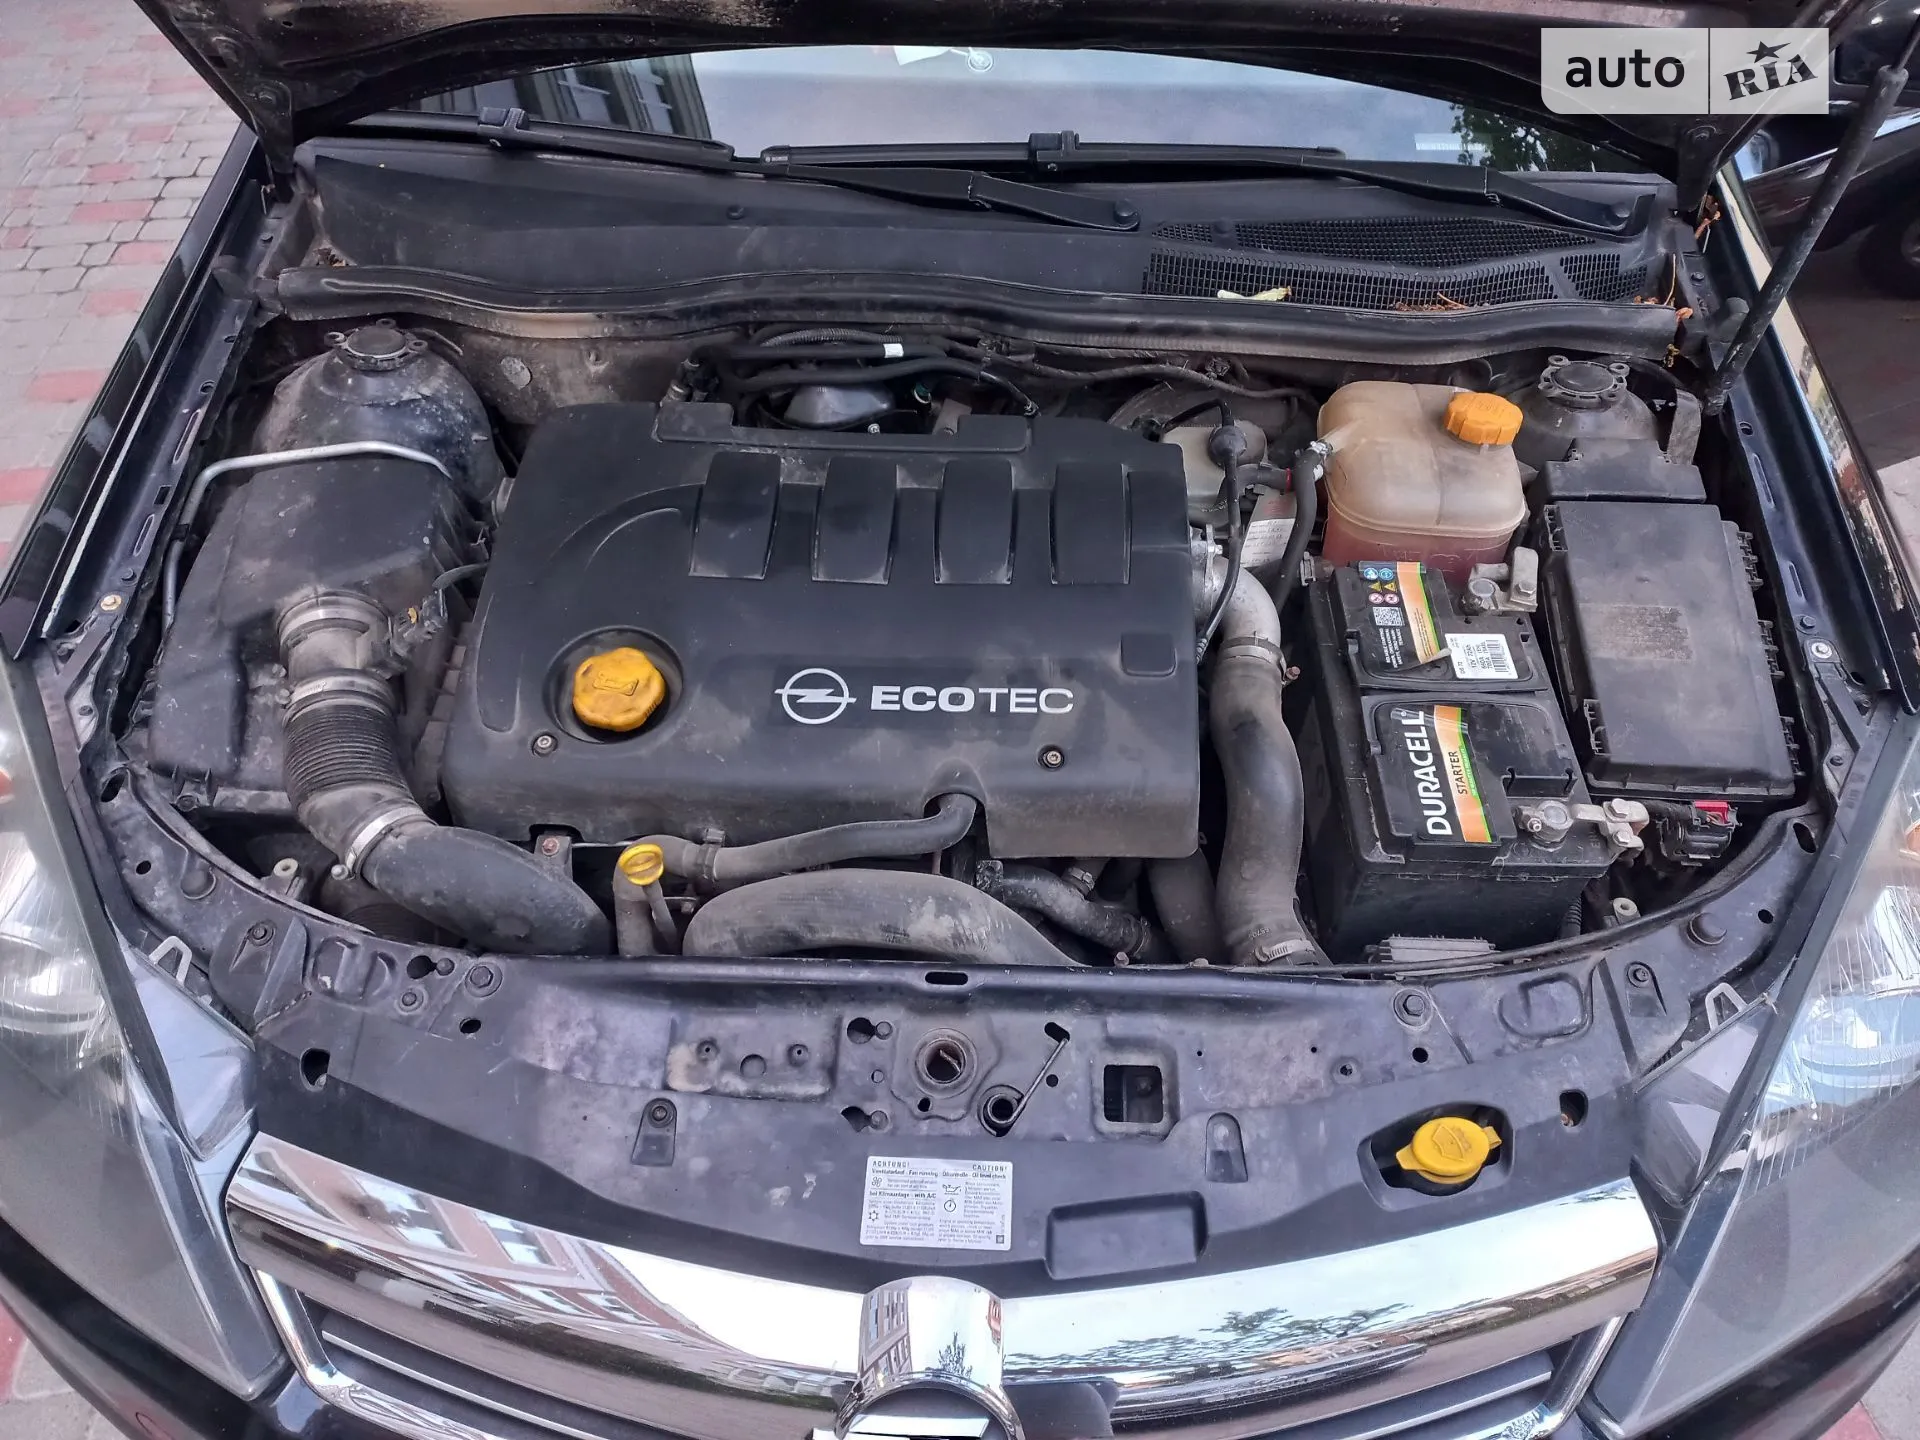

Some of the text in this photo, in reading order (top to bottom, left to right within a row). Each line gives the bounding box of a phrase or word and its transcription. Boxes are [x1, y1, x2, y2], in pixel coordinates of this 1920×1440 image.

[870, 685, 1074, 714] ECOTEC
[1401, 711, 1453, 836] DURACELL
[1449, 750, 1468, 795] STARTER
[872, 1160, 910, 1168] ACHTUNG!
[972, 1164, 1007, 1172] CAUTION!
